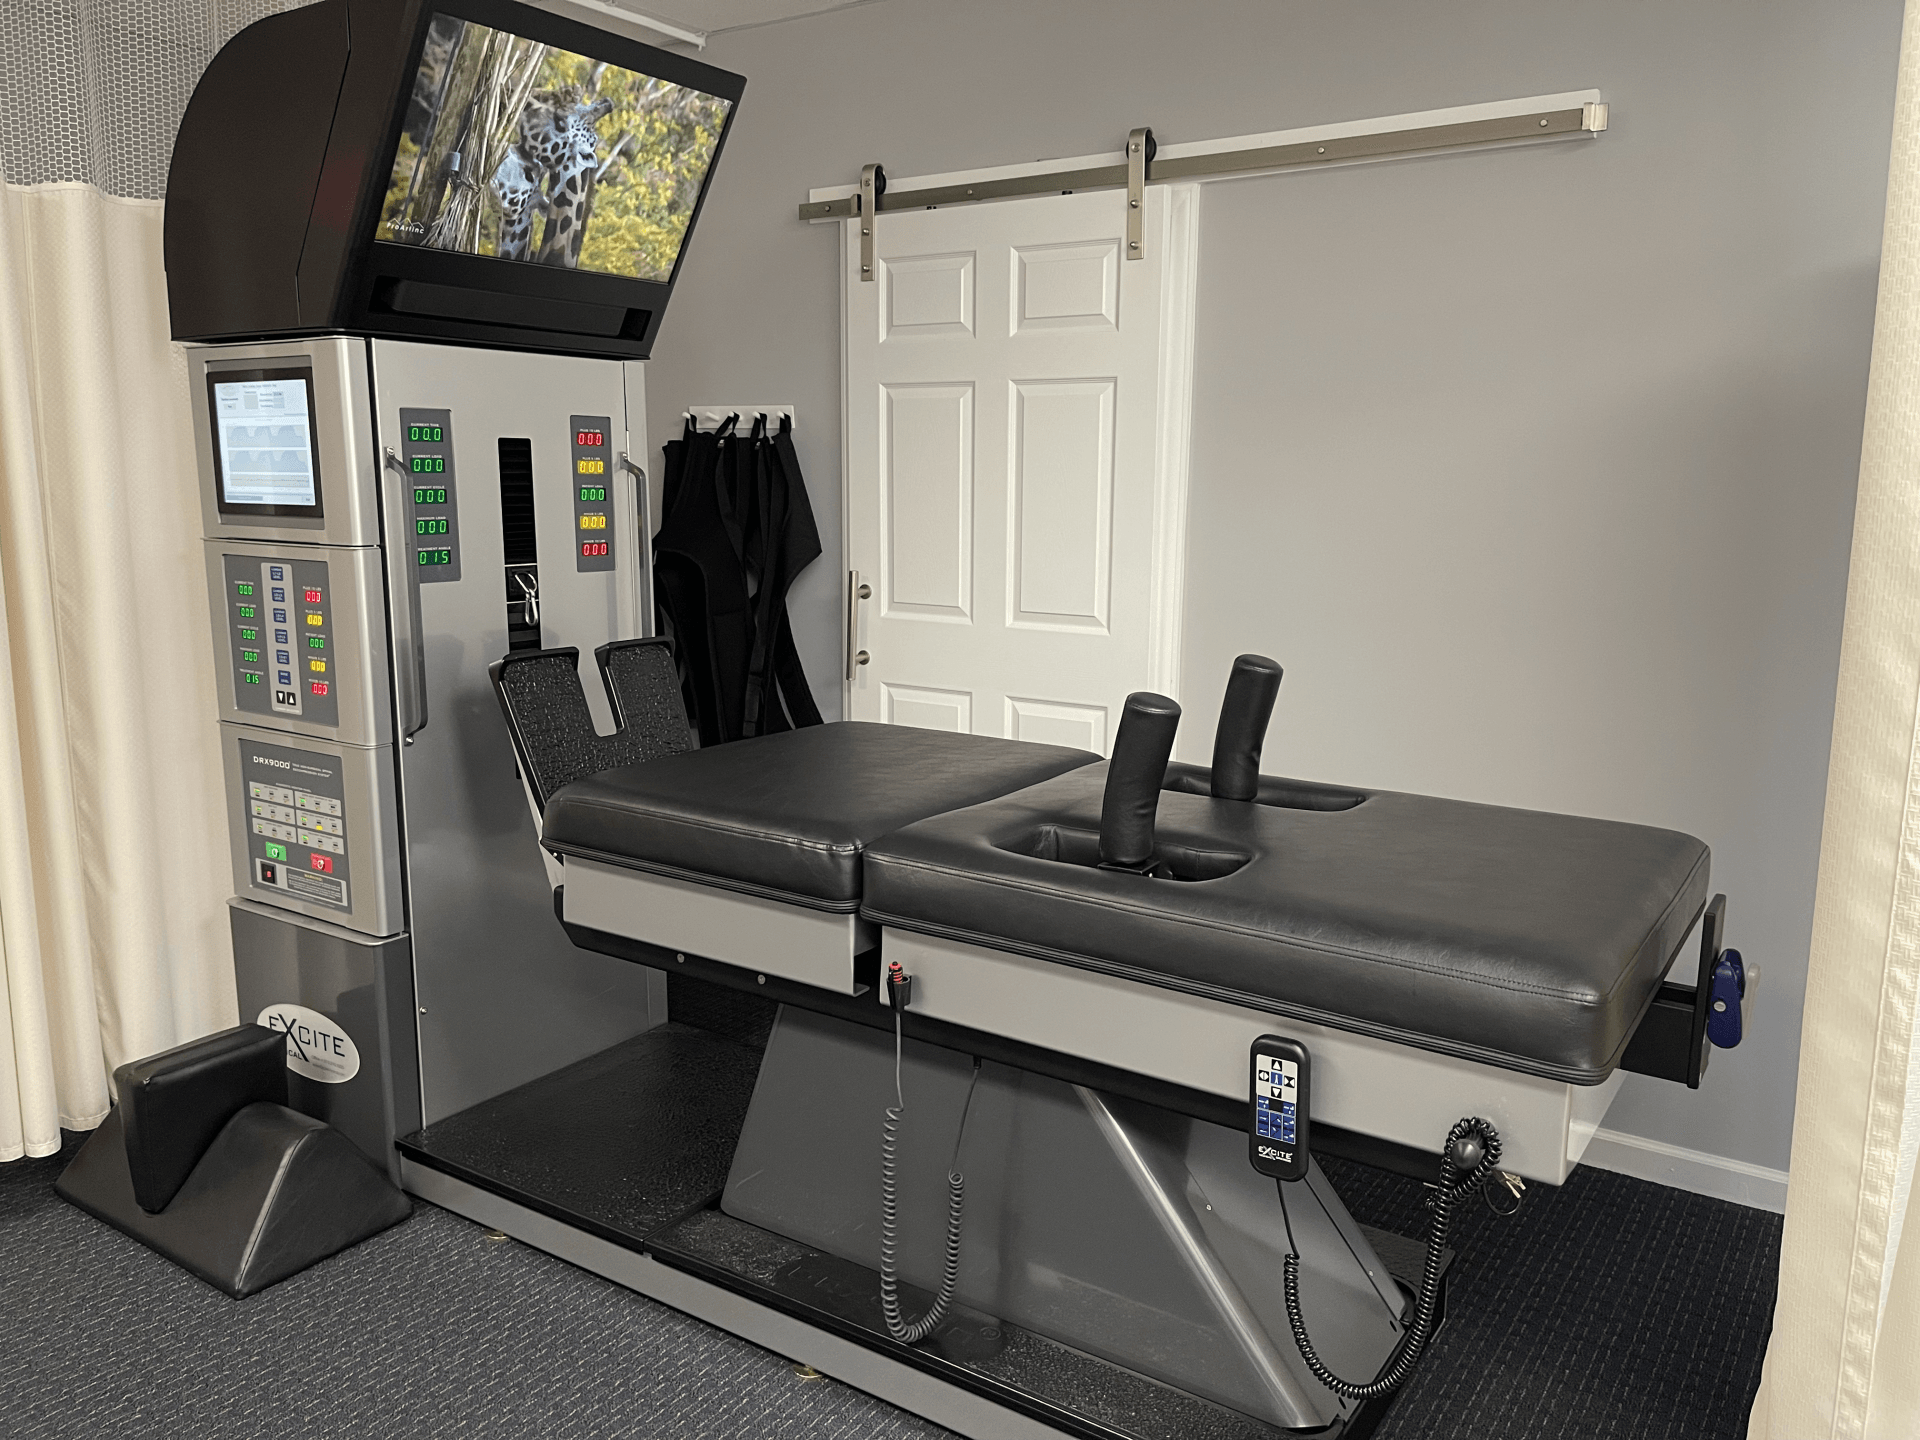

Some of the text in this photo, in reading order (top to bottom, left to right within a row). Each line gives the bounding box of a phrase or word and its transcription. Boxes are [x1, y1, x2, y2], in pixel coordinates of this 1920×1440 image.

[578, 433, 603, 445] 000
[413, 459, 443, 472] 000
[415, 490, 445, 503] 000
[581, 488, 605, 501] 000
[417, 520, 447, 534] 000
[583, 543, 607, 556] 000
[419, 551, 449, 565] 015
[253, 756, 290, 770] DRX9000
[1258, 1145, 1293, 1161] EXCITE
